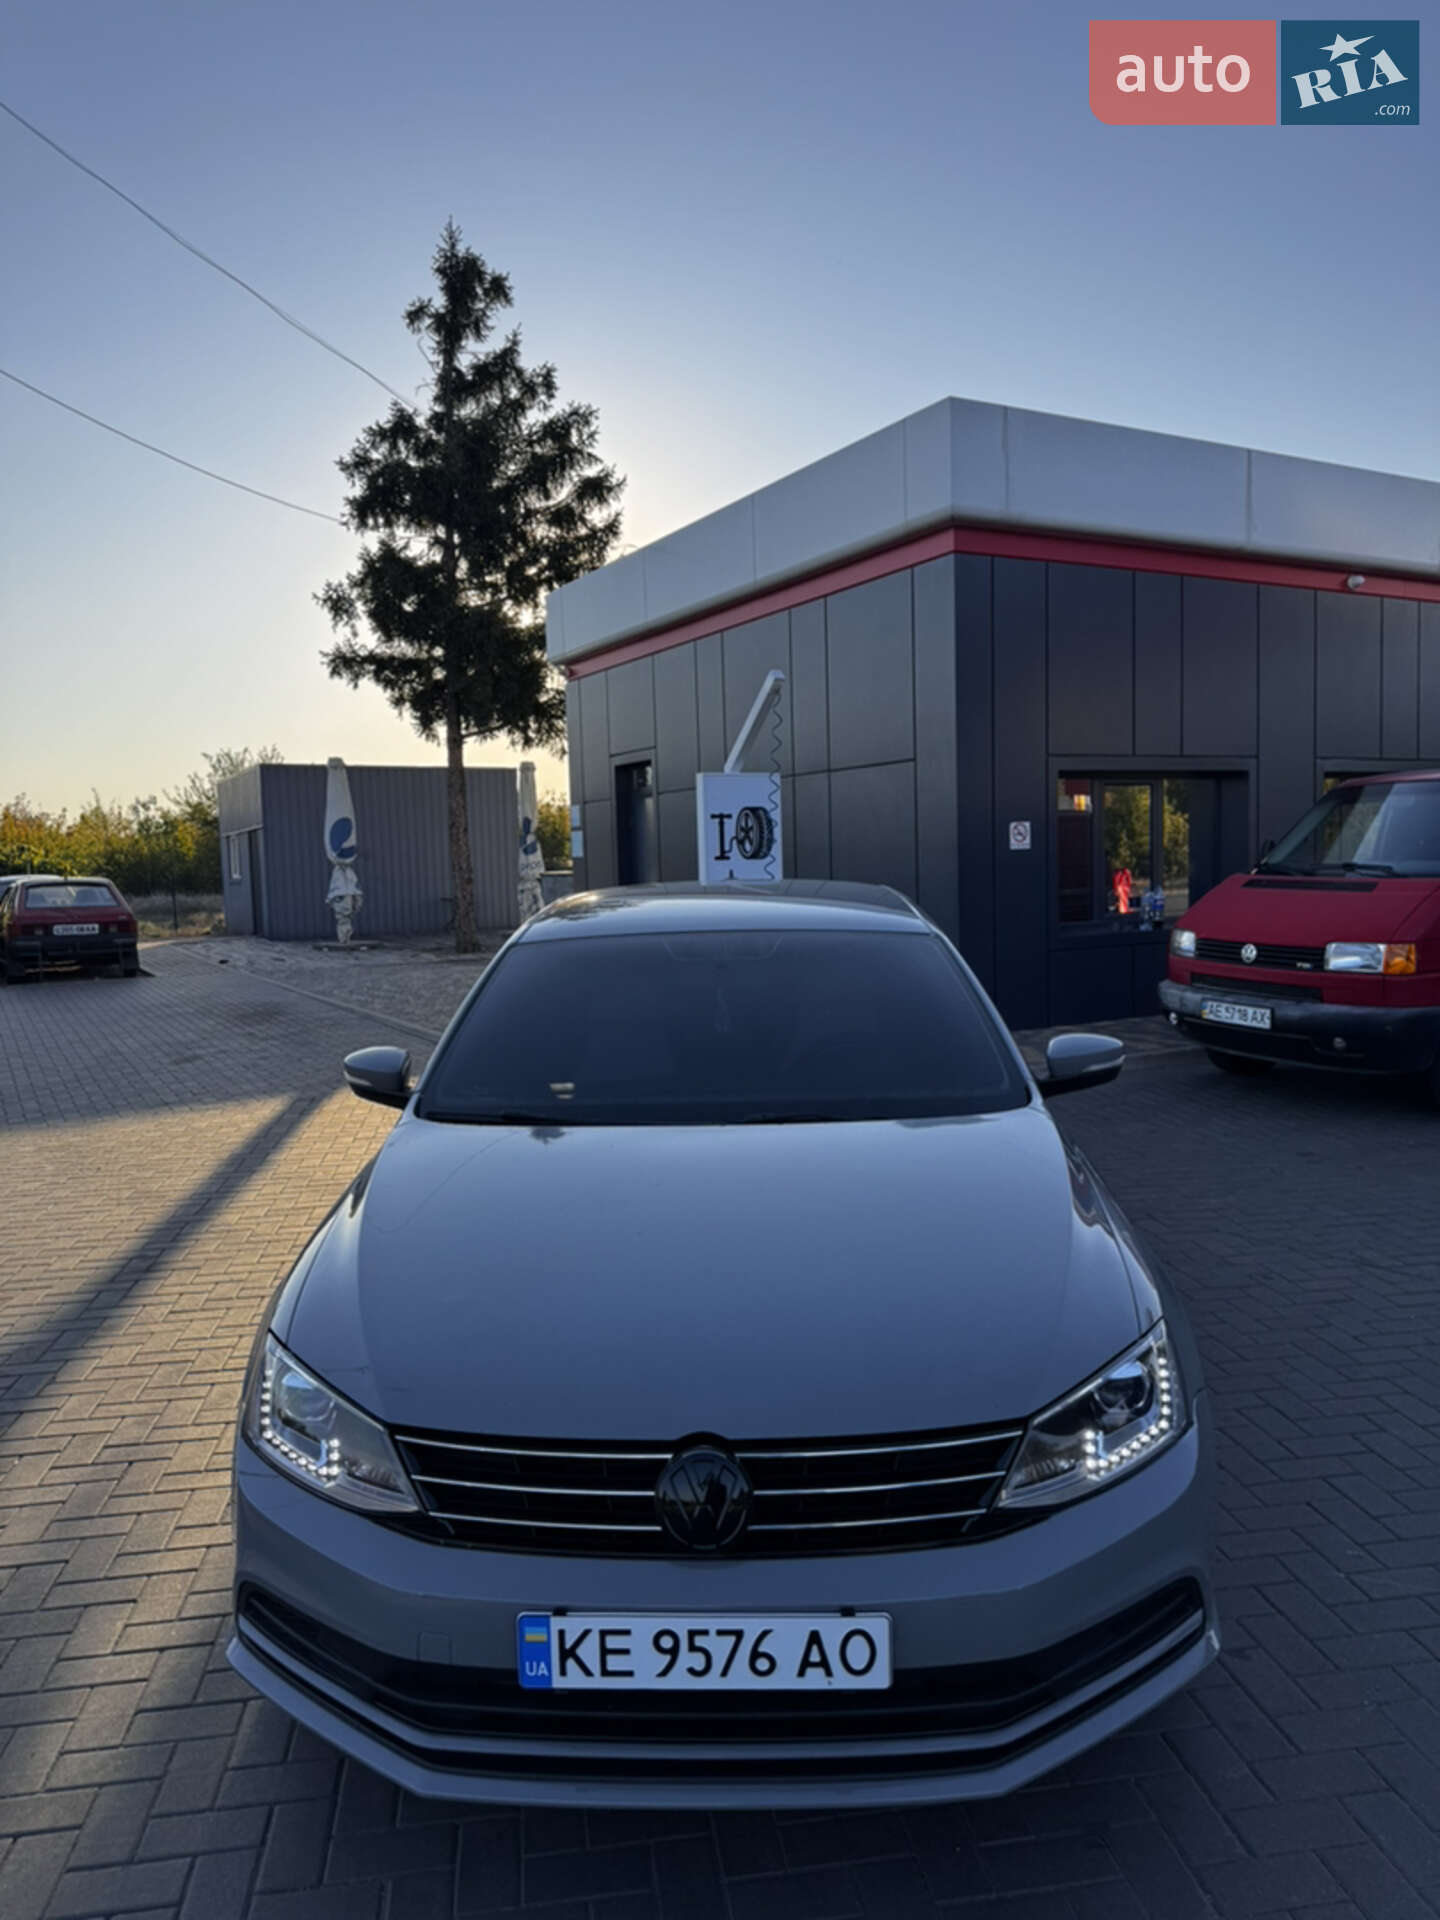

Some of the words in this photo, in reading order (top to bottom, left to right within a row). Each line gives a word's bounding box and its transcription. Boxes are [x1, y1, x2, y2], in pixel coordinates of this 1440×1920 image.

[557, 1628, 635, 1678] KE
[652, 1628, 777, 1678] 9576
[795, 1627, 877, 1678] AO
[524, 1662, 549, 1677] UA
